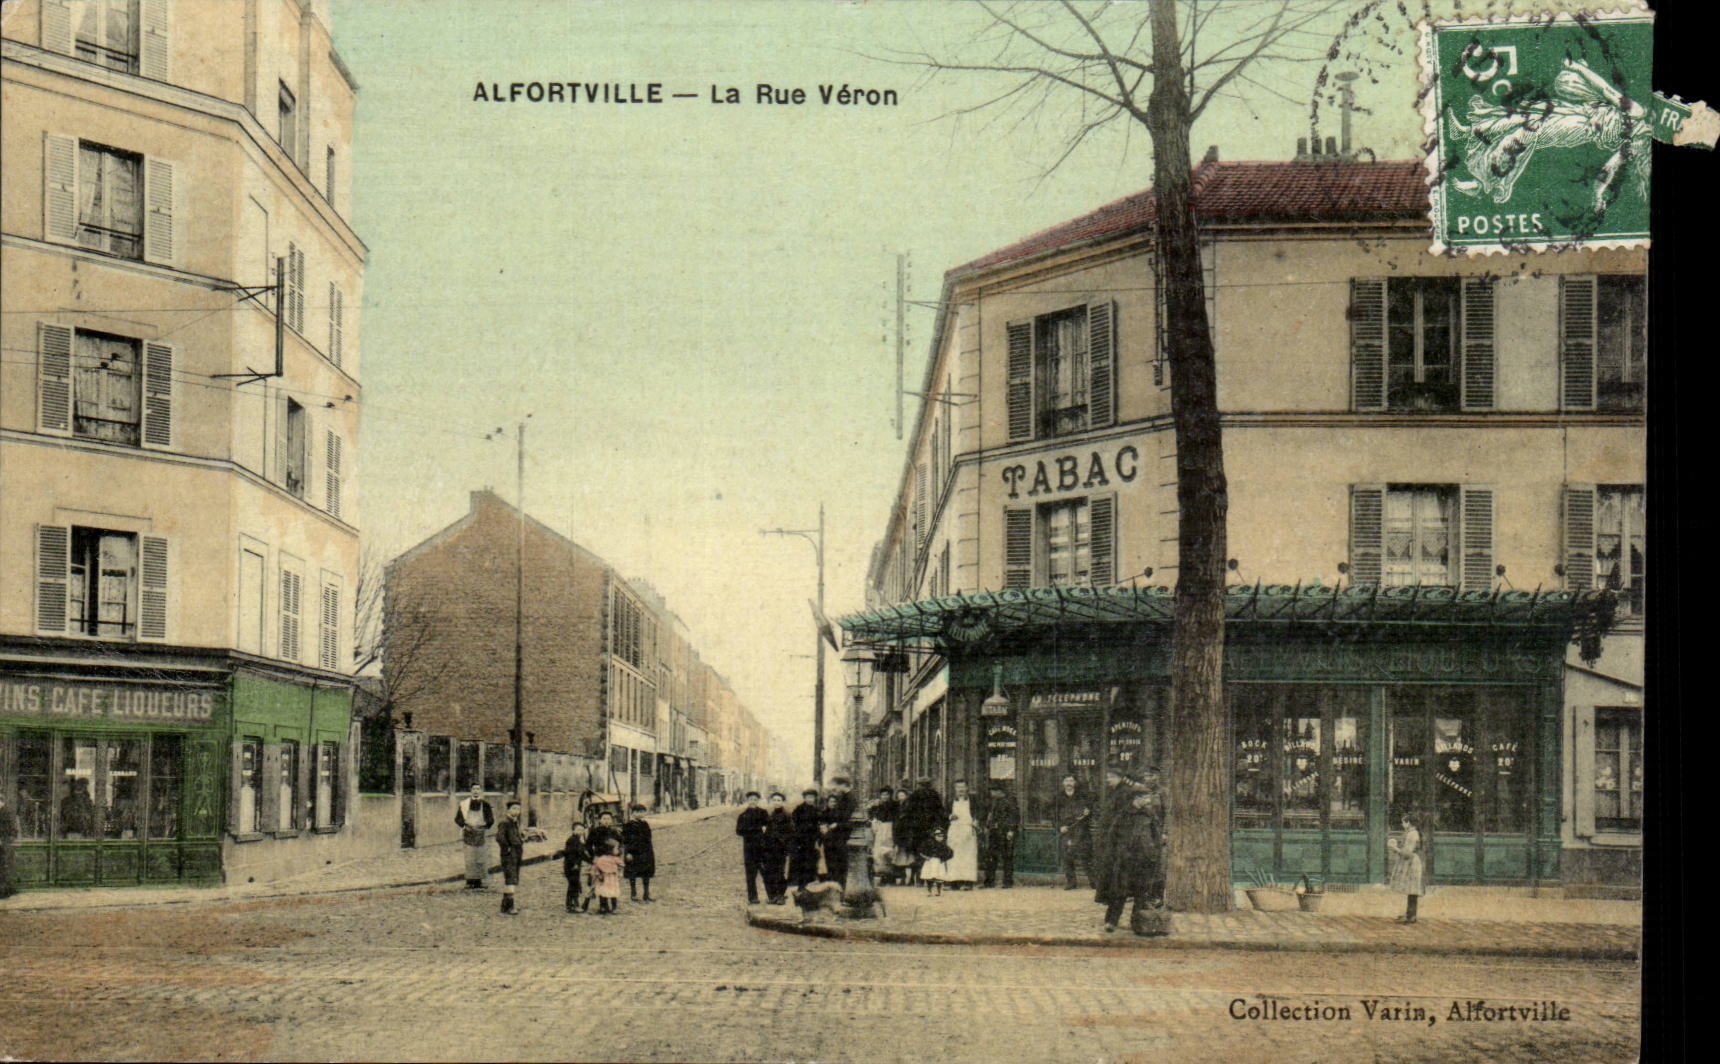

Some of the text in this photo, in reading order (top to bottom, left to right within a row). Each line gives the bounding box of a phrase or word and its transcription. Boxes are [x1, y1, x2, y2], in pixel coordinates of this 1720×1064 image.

[1458, 213, 1542, 234] POSTES
[1002, 445, 1138, 498] TABAC
[0, 682, 41, 711] INS
[112, 689, 213, 718] LIQUEURS
[1241, 739, 1267, 749] BOCK
[1394, 758, 1419, 766] VARIN
